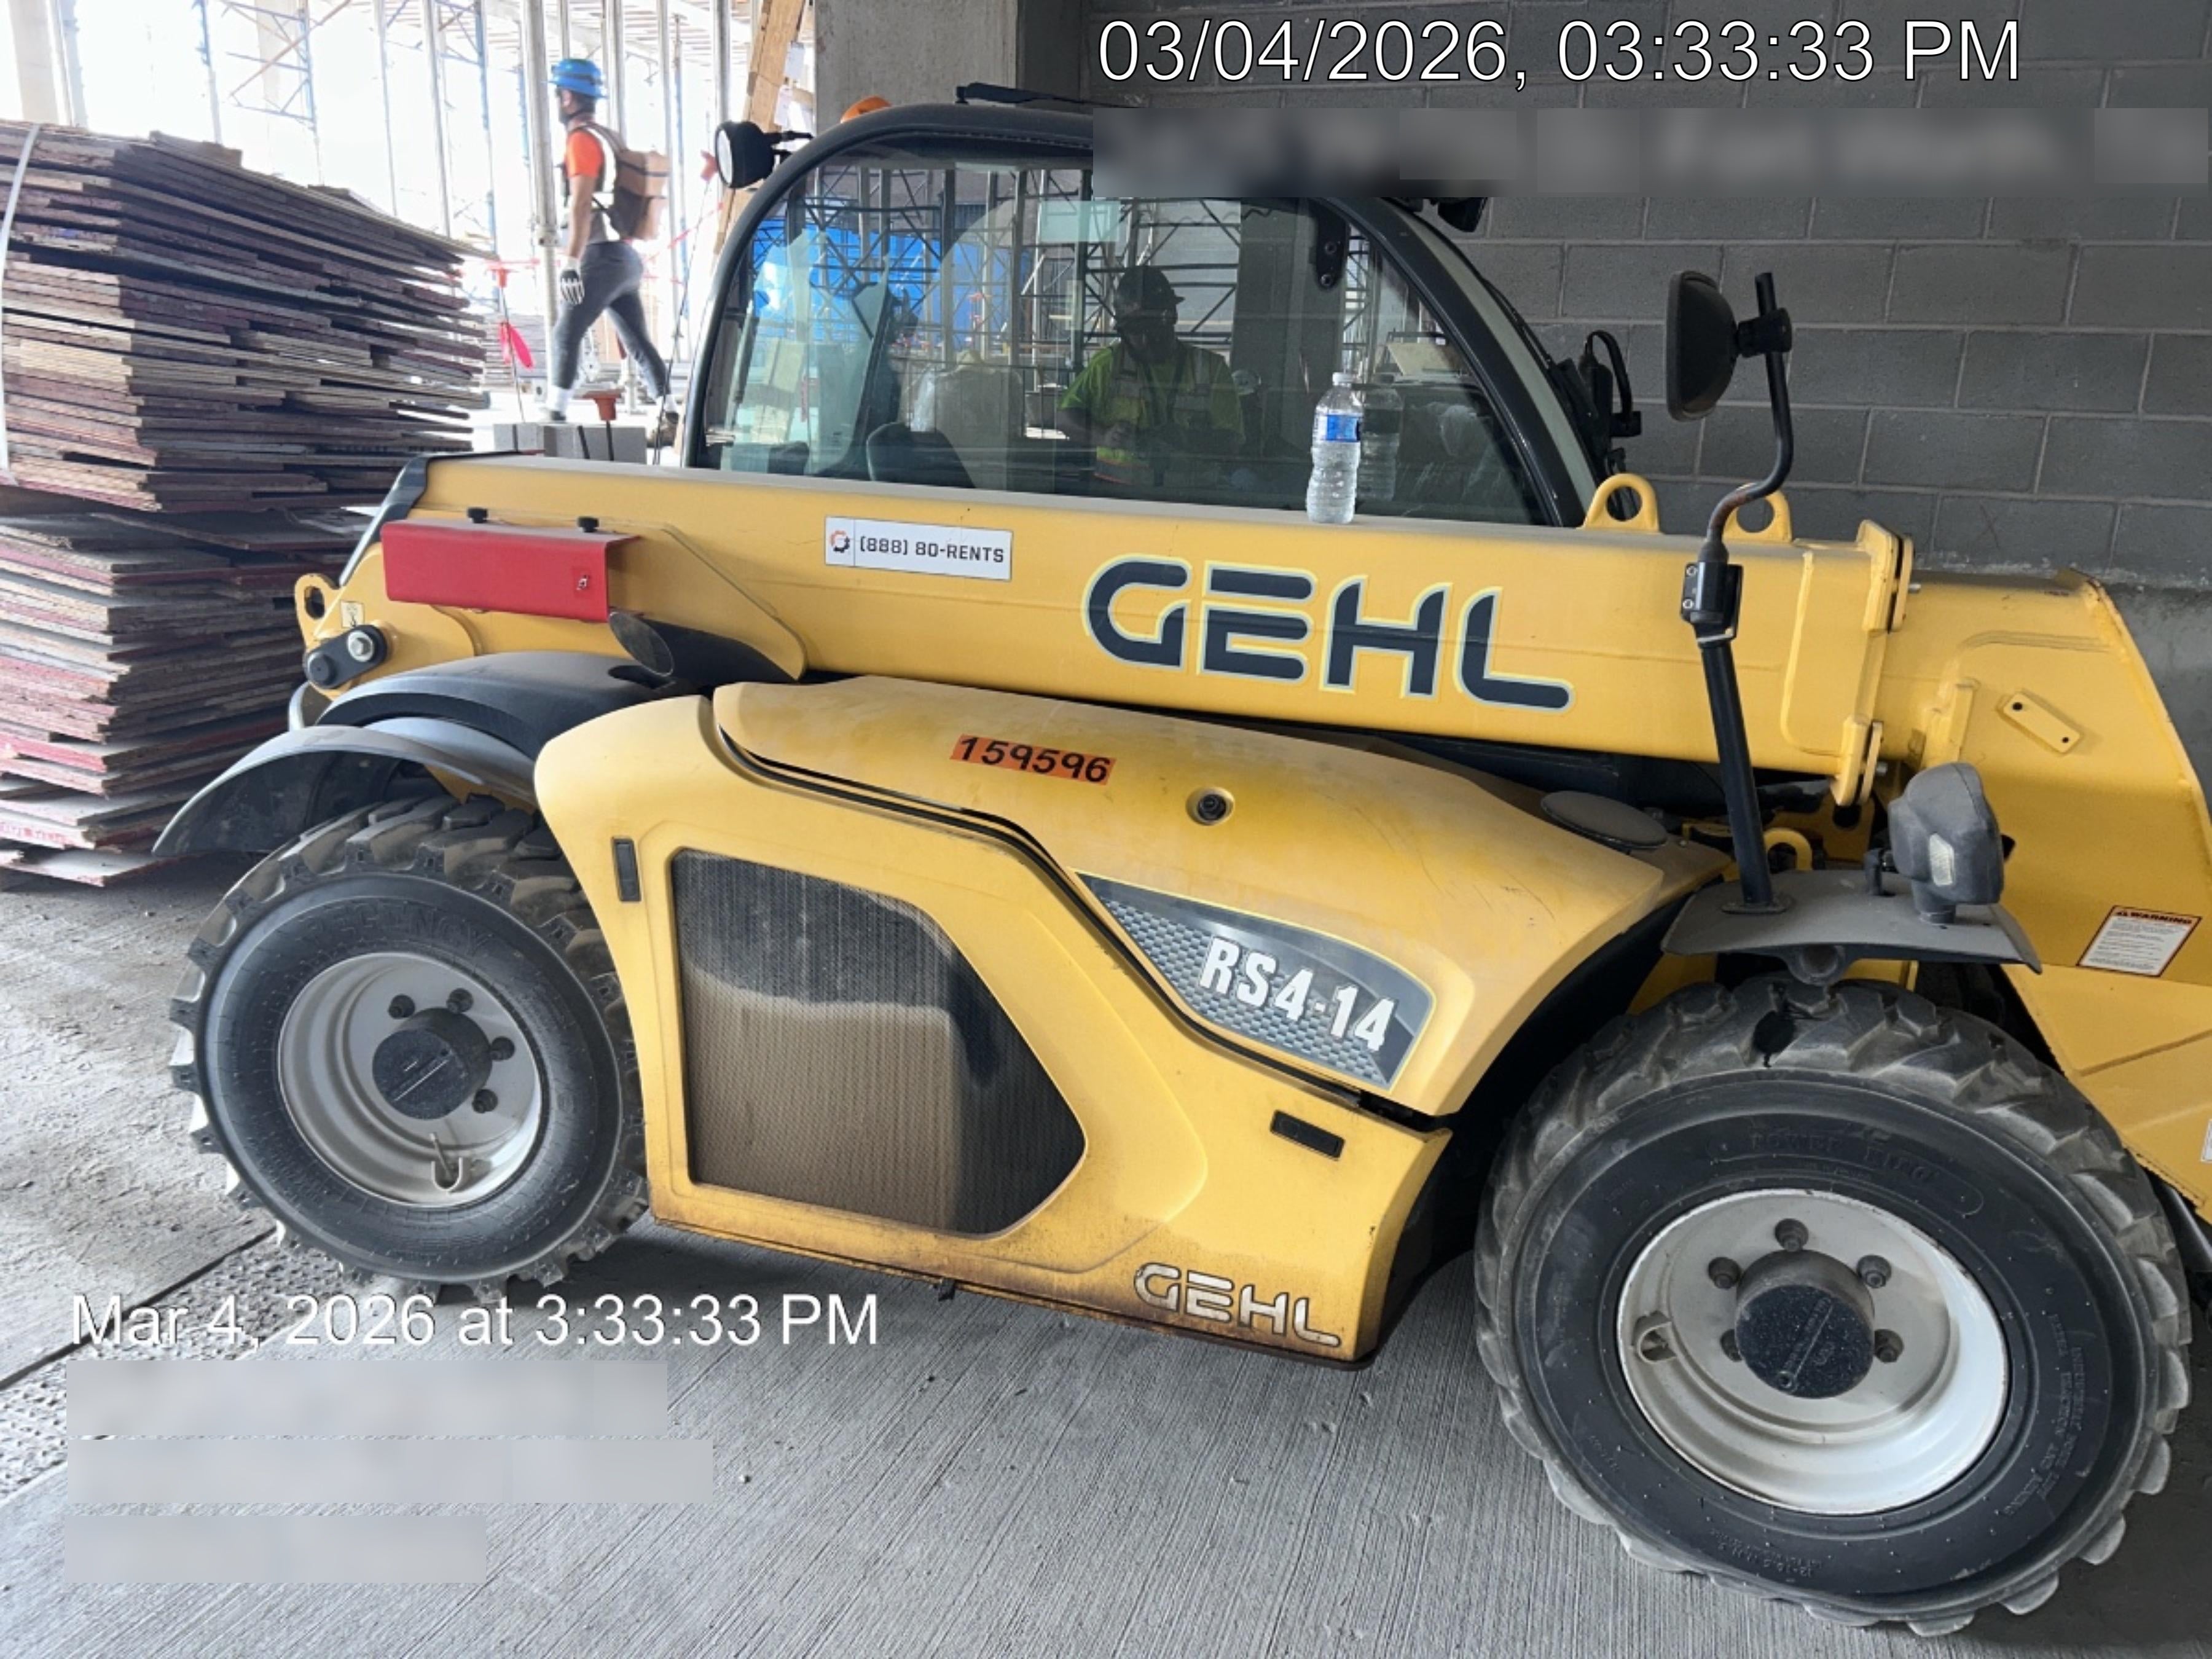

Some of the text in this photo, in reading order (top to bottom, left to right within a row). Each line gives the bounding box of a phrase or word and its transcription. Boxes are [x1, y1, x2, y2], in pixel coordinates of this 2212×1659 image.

[860, 535, 908, 555] (888)
[1083, 554, 1574, 713] GEHL
[960, 737, 1111, 783] 159596
[1199, 935, 1396, 1052] RS4-14
[1133, 1261, 1342, 1348] GEHL
